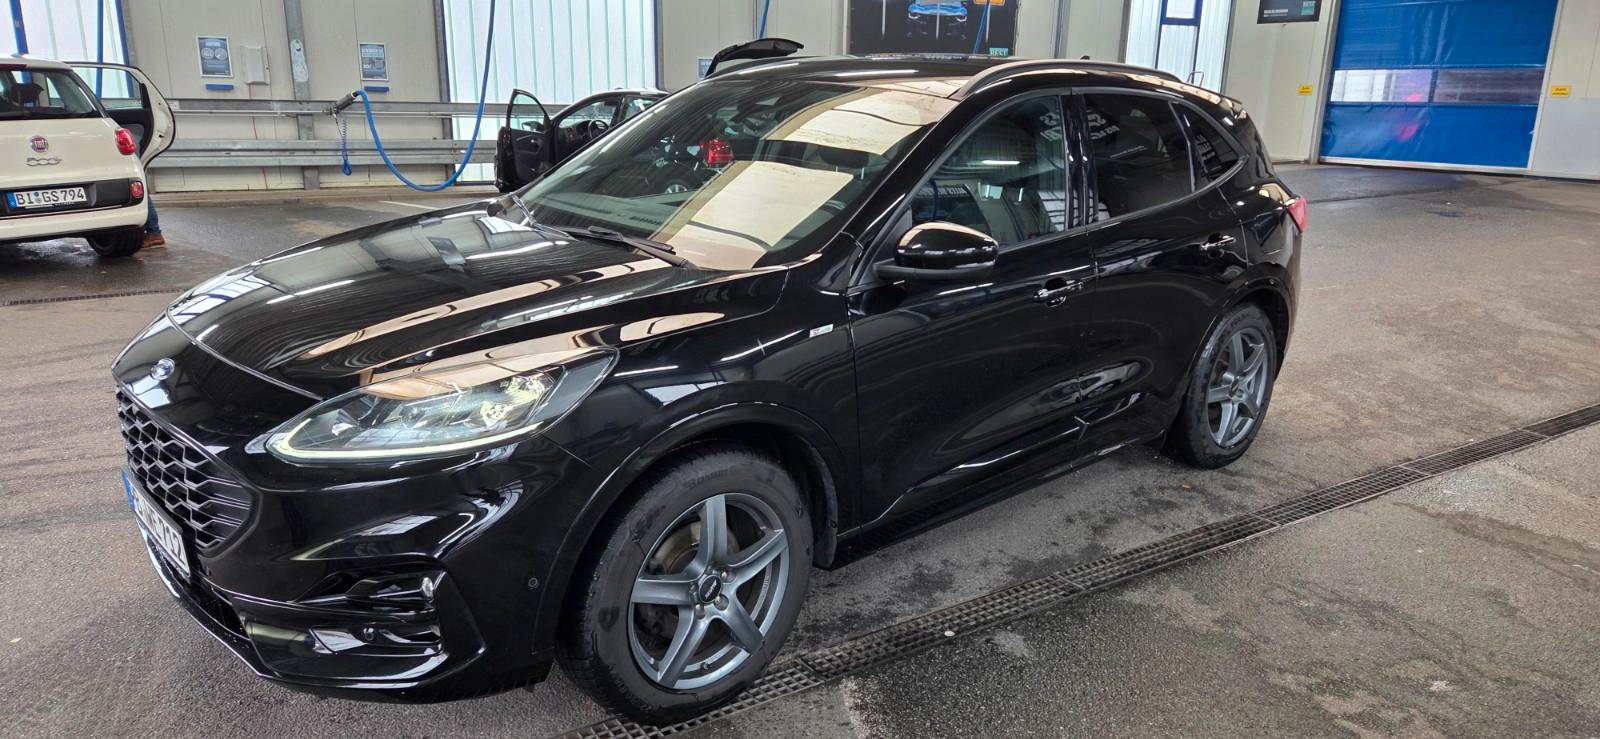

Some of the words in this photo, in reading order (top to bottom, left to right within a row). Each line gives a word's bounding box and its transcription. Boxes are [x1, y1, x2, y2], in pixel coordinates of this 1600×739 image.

[15, 193, 34, 205] BI
[41, 191, 60, 203] GS
[60, 188, 84, 201] 794
[158, 516, 186, 566] 712
